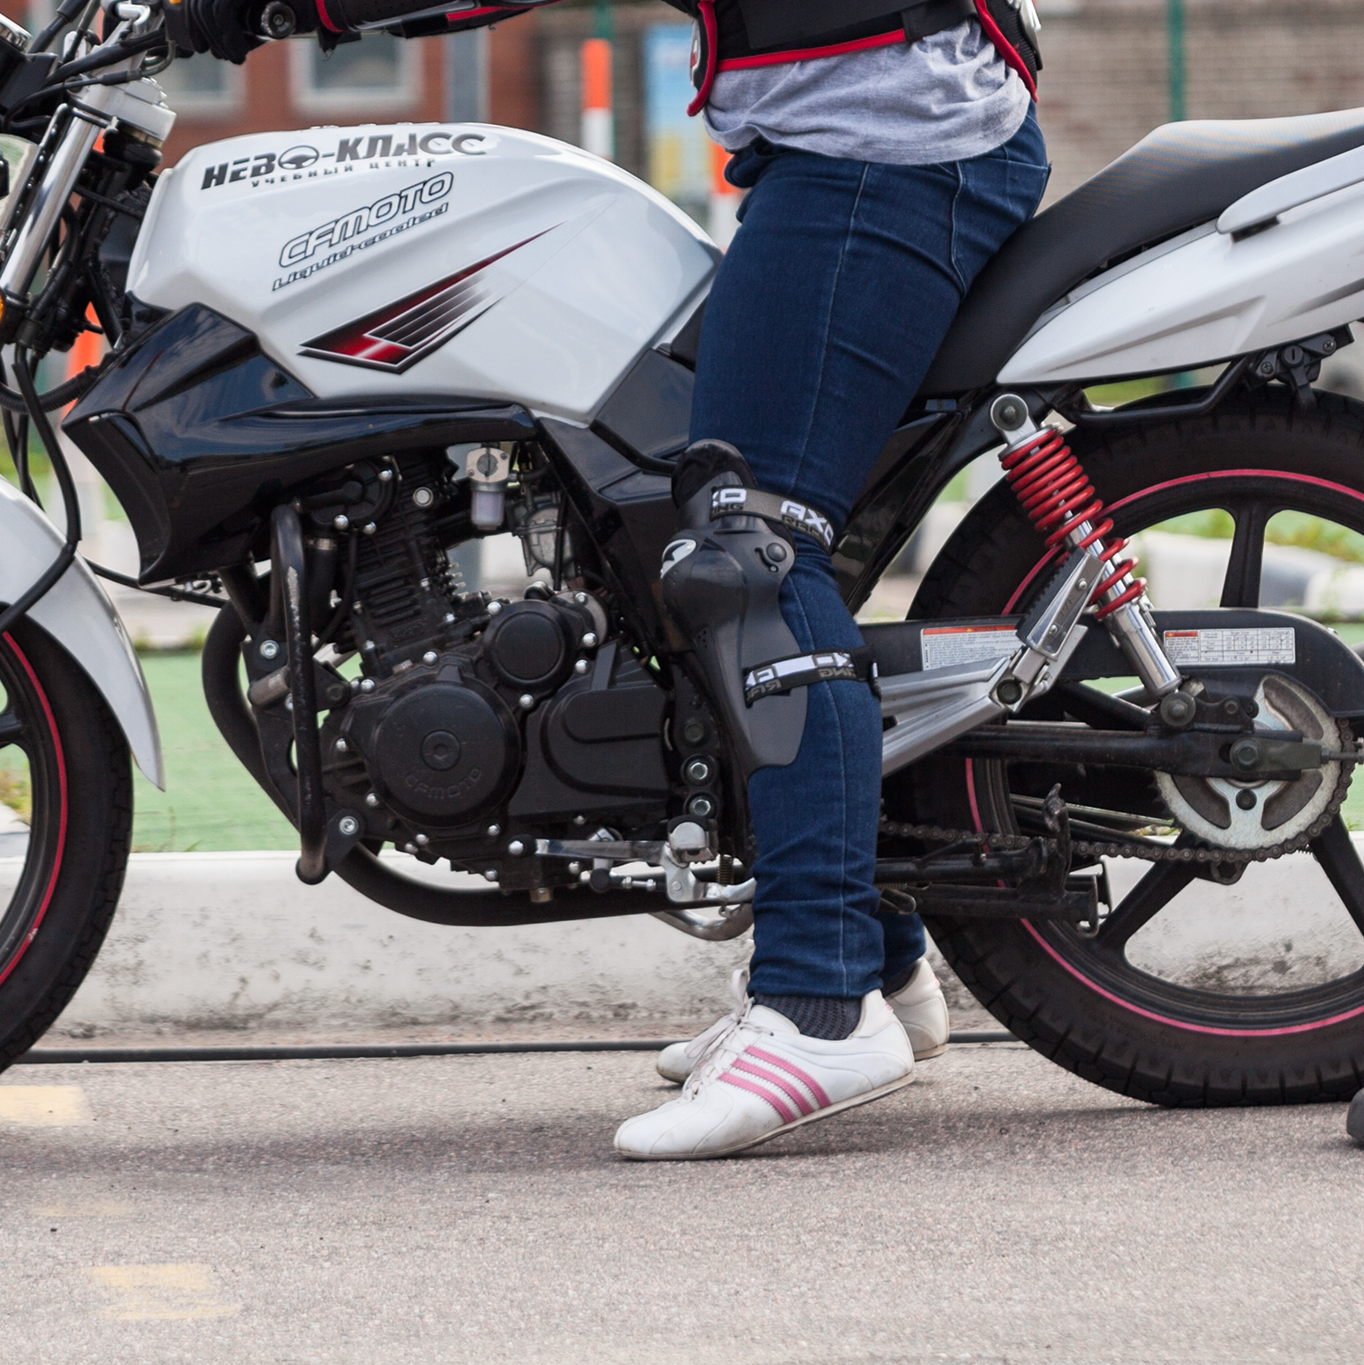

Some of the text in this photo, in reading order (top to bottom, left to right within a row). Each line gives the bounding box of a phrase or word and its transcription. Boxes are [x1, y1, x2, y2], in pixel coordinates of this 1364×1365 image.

[251, 158, 435, 188] УЧЕБНЫЙ ЦЕНТР
[278, 171, 454, 268] CFMOTO
